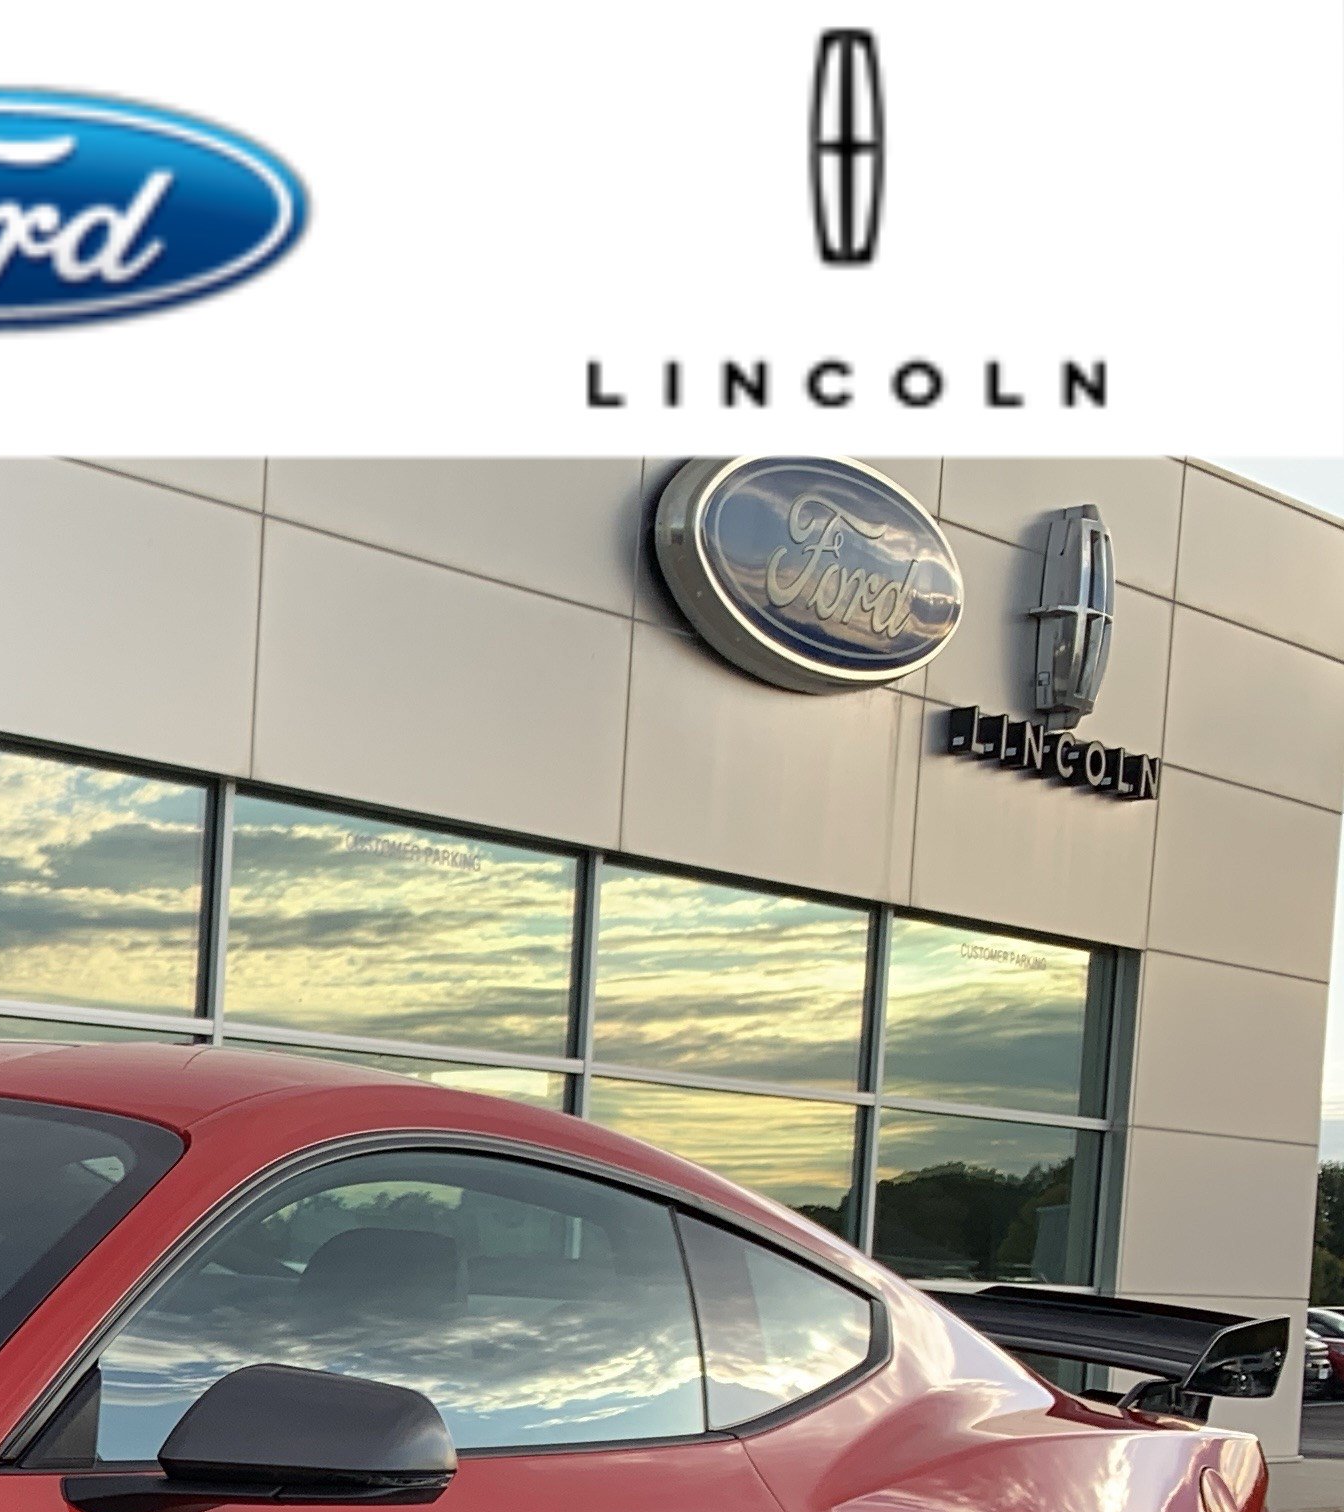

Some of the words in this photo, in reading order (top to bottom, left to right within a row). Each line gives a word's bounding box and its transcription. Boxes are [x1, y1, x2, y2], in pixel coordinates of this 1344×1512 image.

[766, 494, 918, 638] Ford
[966, 705, 1161, 800] LINCOLN
[960, 943, 1009, 963] CUSTOMER
[1011, 951, 1047, 970] PARKING
